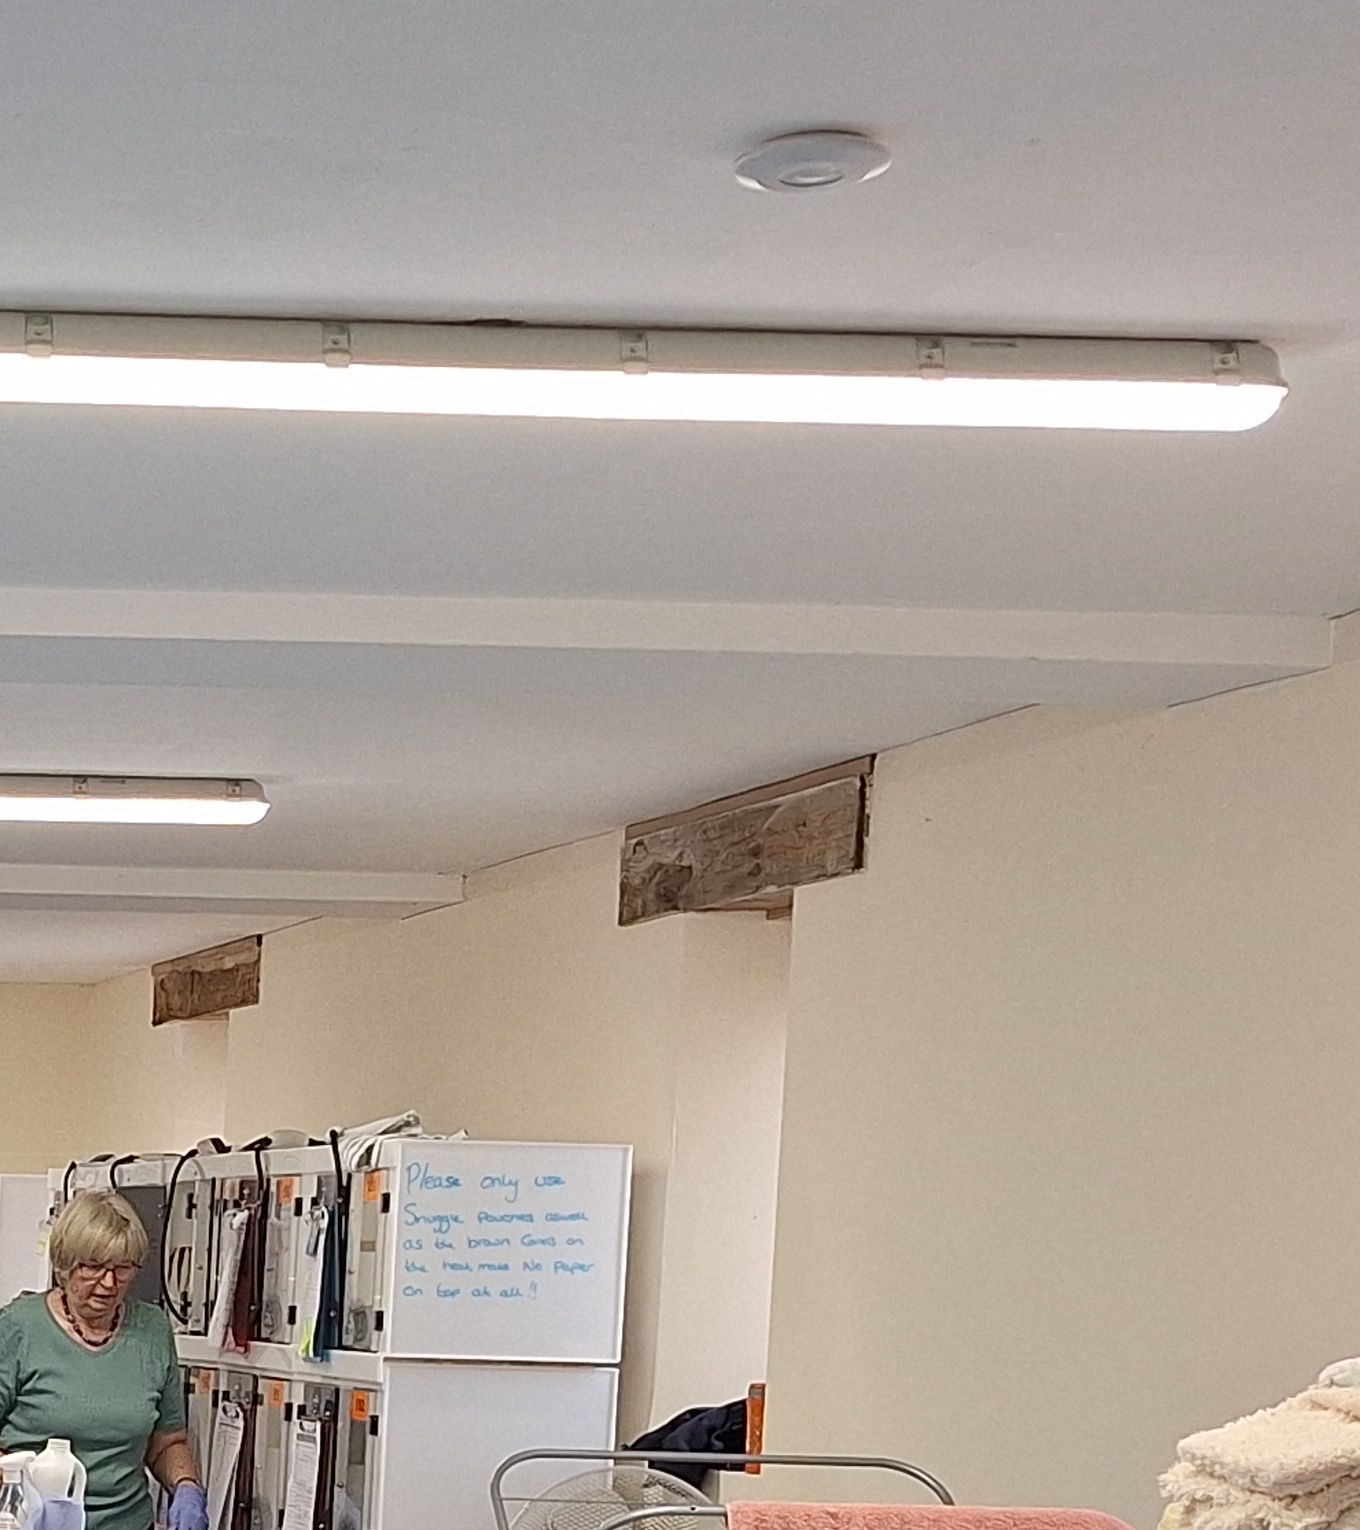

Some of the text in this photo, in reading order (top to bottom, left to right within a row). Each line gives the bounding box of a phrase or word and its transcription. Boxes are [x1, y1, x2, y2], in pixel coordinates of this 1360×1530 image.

[405, 1161, 567, 1203] Please only use
[402, 1238, 424, 1250] as
[433, 1236, 457, 1250] the
[466, 1234, 512, 1249] brown
[565, 1237, 585, 1246] on
[404, 1257, 429, 1273] the
[522, 1260, 544, 1273] No
[435, 1282, 461, 1299] top
[498, 1286, 524, 1298] all
